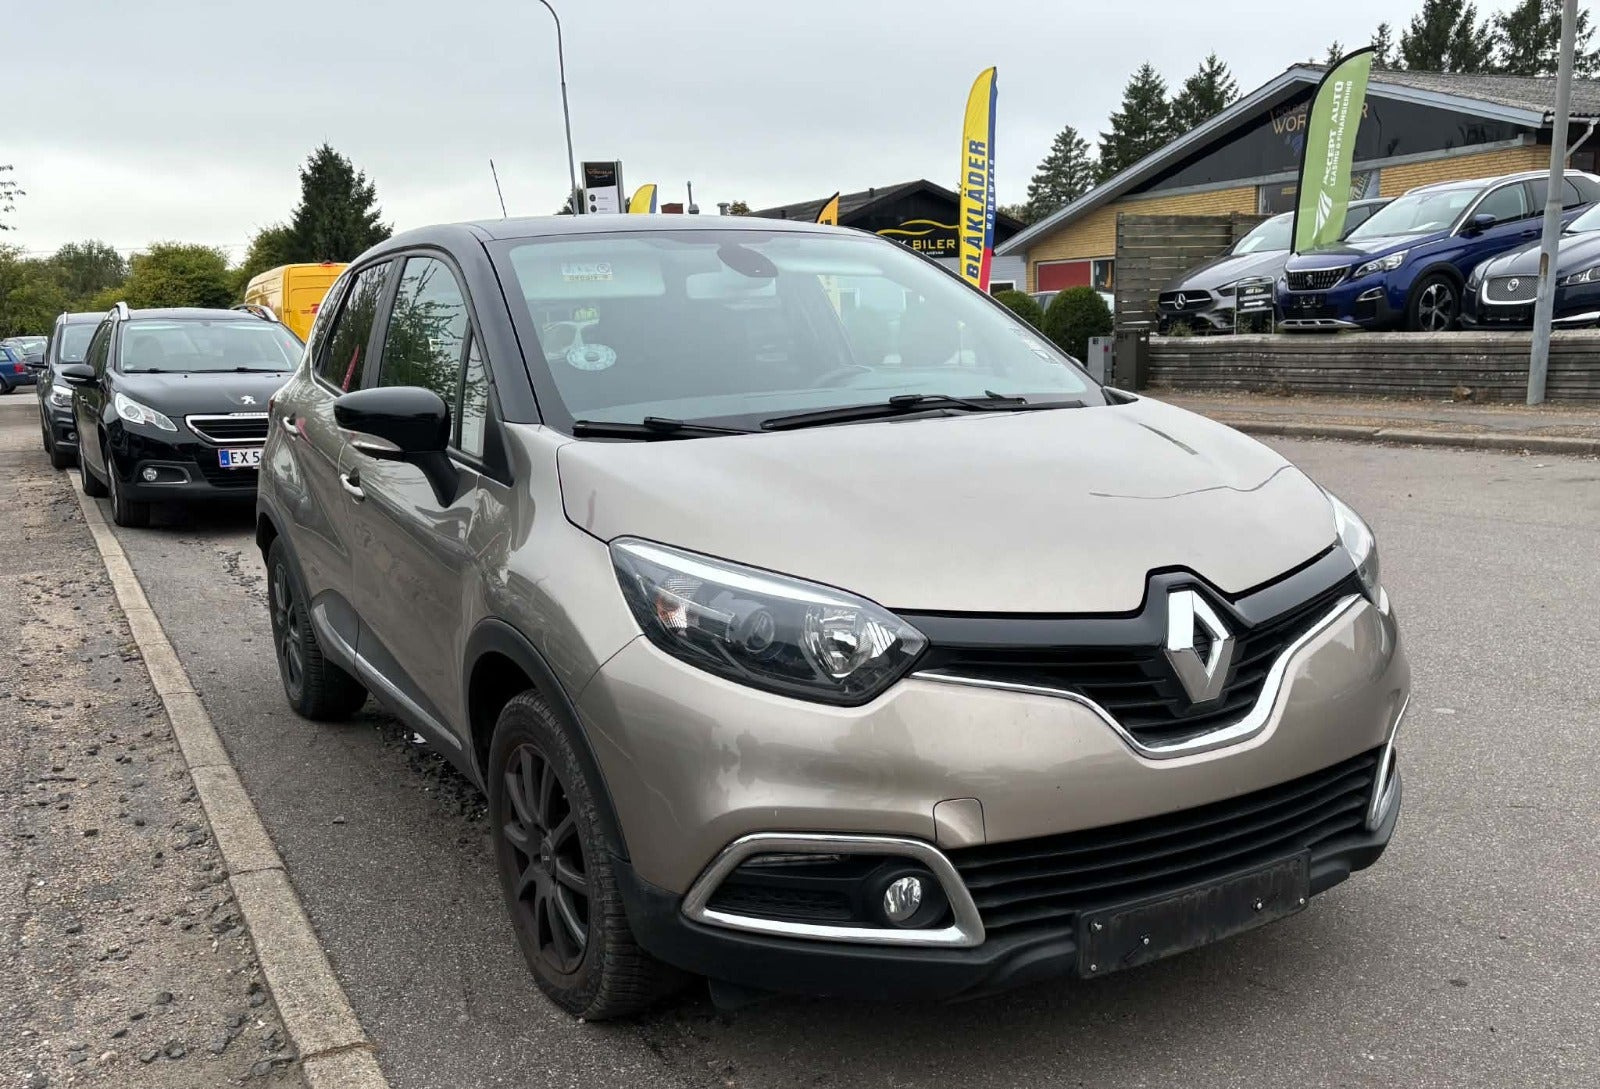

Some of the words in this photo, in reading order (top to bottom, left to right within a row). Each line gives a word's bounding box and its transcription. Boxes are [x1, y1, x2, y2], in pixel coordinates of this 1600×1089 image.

[1322, 129, 1337, 185] ACCEPT
[1331, 80, 1345, 123] AUTO
[1330, 151, 1340, 186] LEASING
[1337, 80, 1353, 141] FINANSIERING
[963, 140, 986, 279] BLÅKLÄDER
[986, 159, 995, 230] WORKWEAR
[912, 239, 956, 249] BILER
[230, 451, 249, 463] EX
